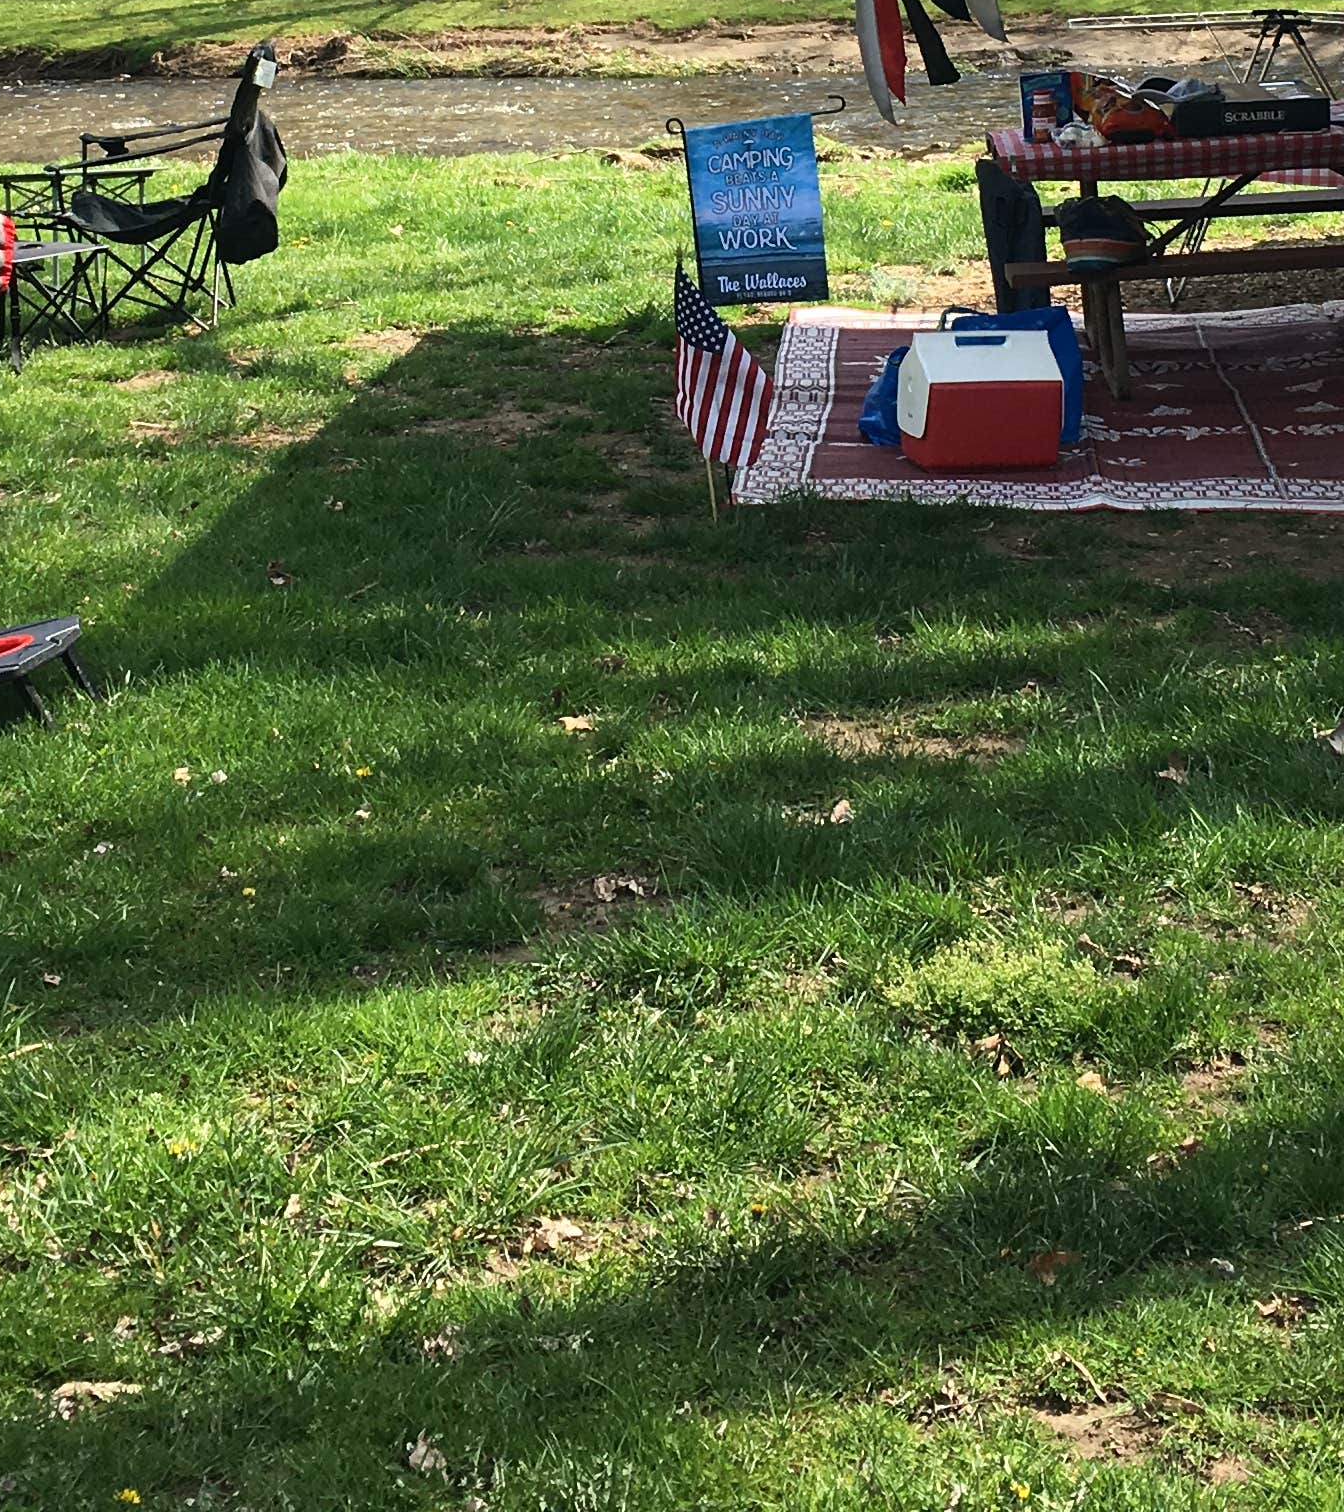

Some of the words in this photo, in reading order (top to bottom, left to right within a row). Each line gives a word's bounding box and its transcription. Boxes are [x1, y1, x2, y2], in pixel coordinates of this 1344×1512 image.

[1224, 110, 1286, 123] SCRABBLE
[708, 146, 794, 174] CAMPING
[725, 171, 767, 186] BEATS
[770, 170, 779, 182] A
[712, 185, 796, 215] SUNNY
[733, 214, 758, 227] DAY
[763, 212, 779, 225] AT
[718, 226, 798, 250] WORK
[717, 275, 741, 293] The
[744, 272, 807, 290] Wallaces
